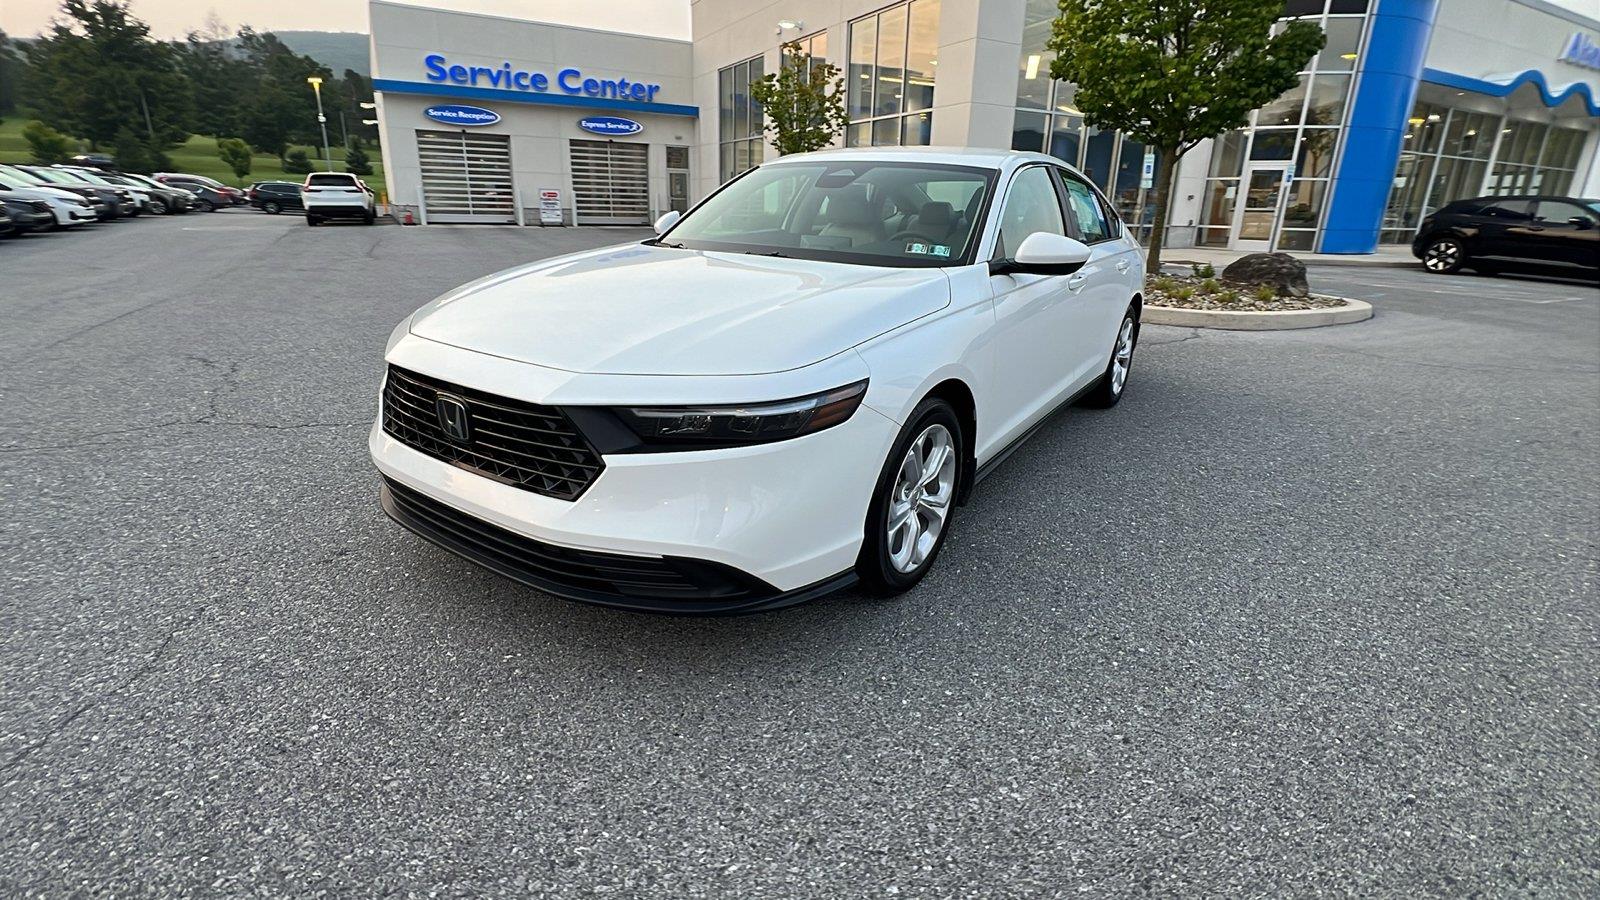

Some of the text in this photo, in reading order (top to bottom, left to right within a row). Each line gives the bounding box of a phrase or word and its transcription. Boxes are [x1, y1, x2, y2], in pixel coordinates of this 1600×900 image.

[425, 54, 660, 102] Service Center
[428, 108, 496, 120] Service Reception
[581, 120, 630, 130] Express Service
